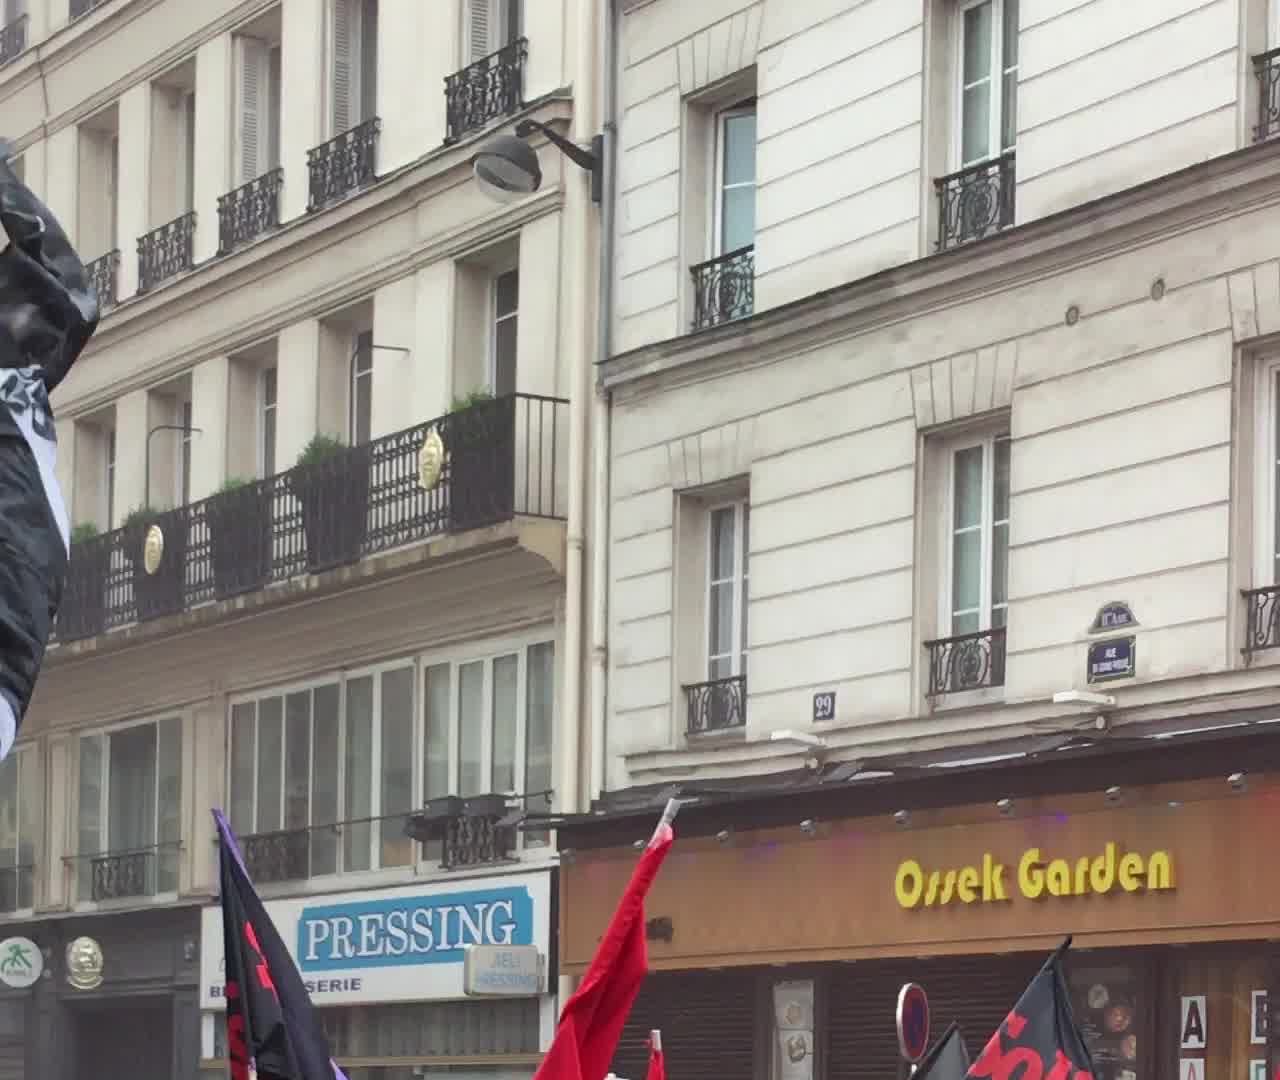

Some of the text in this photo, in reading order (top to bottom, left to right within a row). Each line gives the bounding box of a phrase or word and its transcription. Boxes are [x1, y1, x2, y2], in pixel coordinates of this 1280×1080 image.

[815, 695, 832, 718] 29
[895, 842, 1172, 908] Ossek Garden
[304, 899, 516, 961] PRESSING
[1183, 1000, 1204, 1043] A
